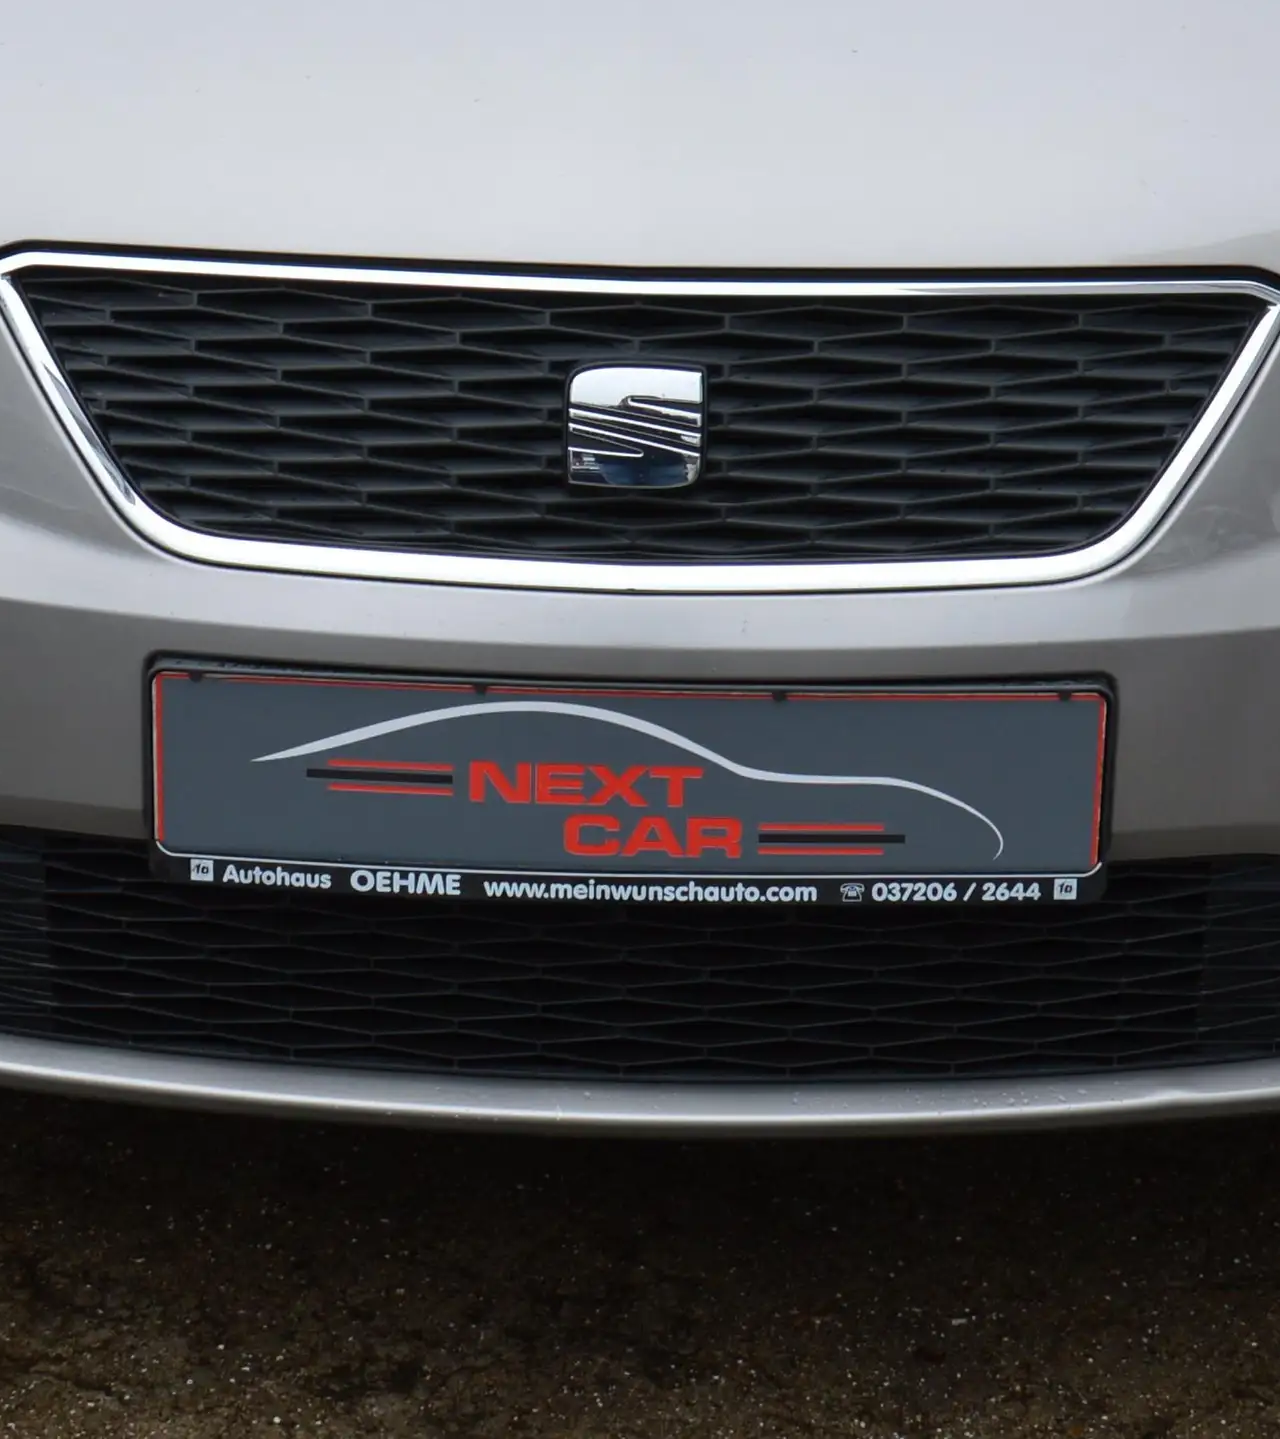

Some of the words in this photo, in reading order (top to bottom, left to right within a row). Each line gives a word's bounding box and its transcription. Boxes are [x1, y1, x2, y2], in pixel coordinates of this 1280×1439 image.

[470, 759, 704, 808] NEXT
[563, 813, 743, 859] CAR
[222, 864, 332, 889] Autohaus
[350, 869, 461, 896] OEHME
[483, 879, 818, 903] www.meinwunschauto.com
[871, 881, 958, 902] 037206
[962, 882, 977, 902] /
[981, 881, 1042, 902] 2644
